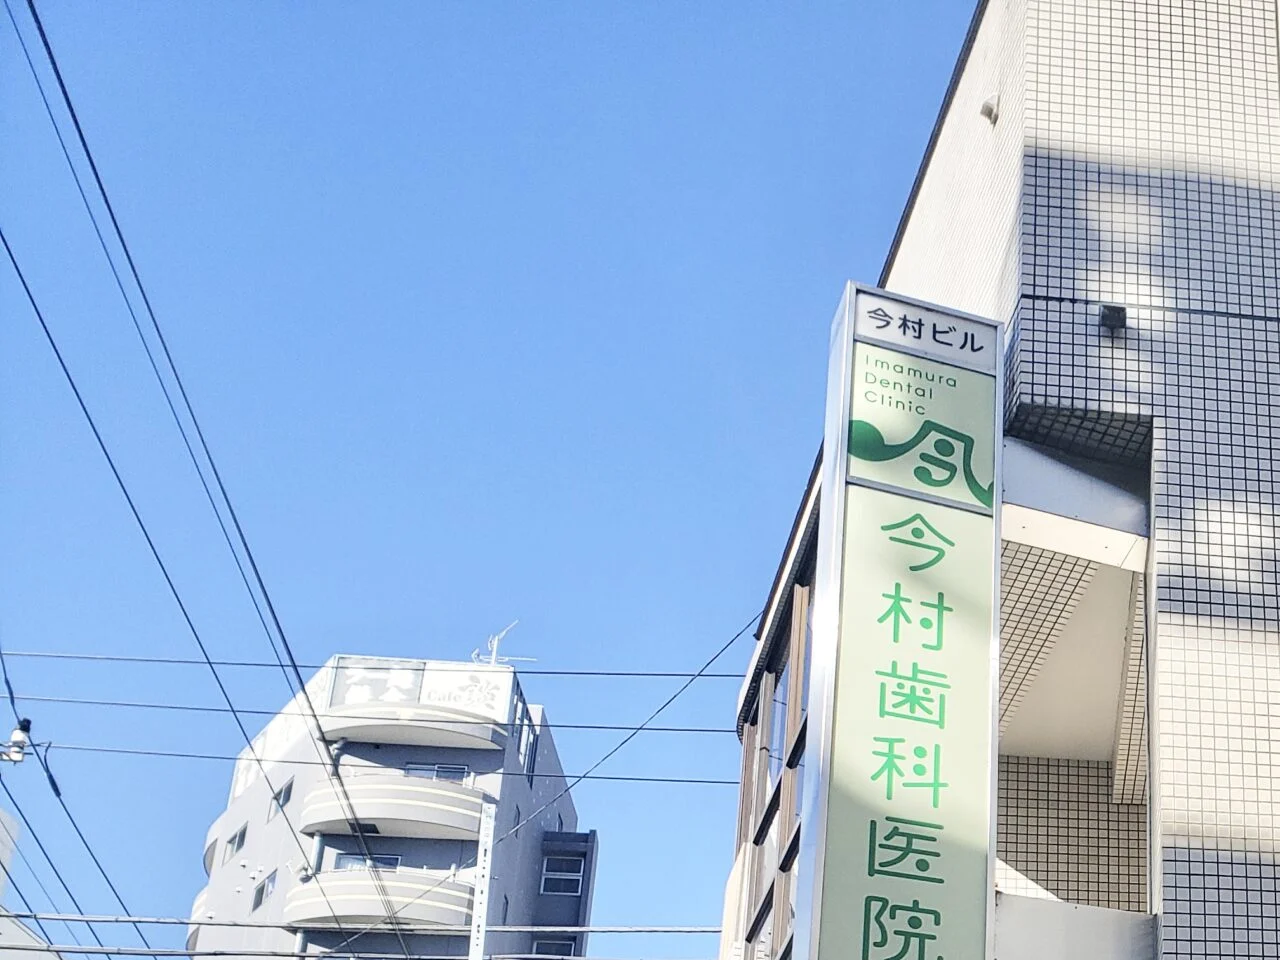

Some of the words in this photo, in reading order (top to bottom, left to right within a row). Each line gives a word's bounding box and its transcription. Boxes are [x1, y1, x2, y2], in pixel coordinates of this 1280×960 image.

[867, 307, 985, 353] 今村ビル
[865, 354, 957, 388] Imamura
[865, 372, 934, 400] Dental
[864, 390, 926, 416] Clinic
